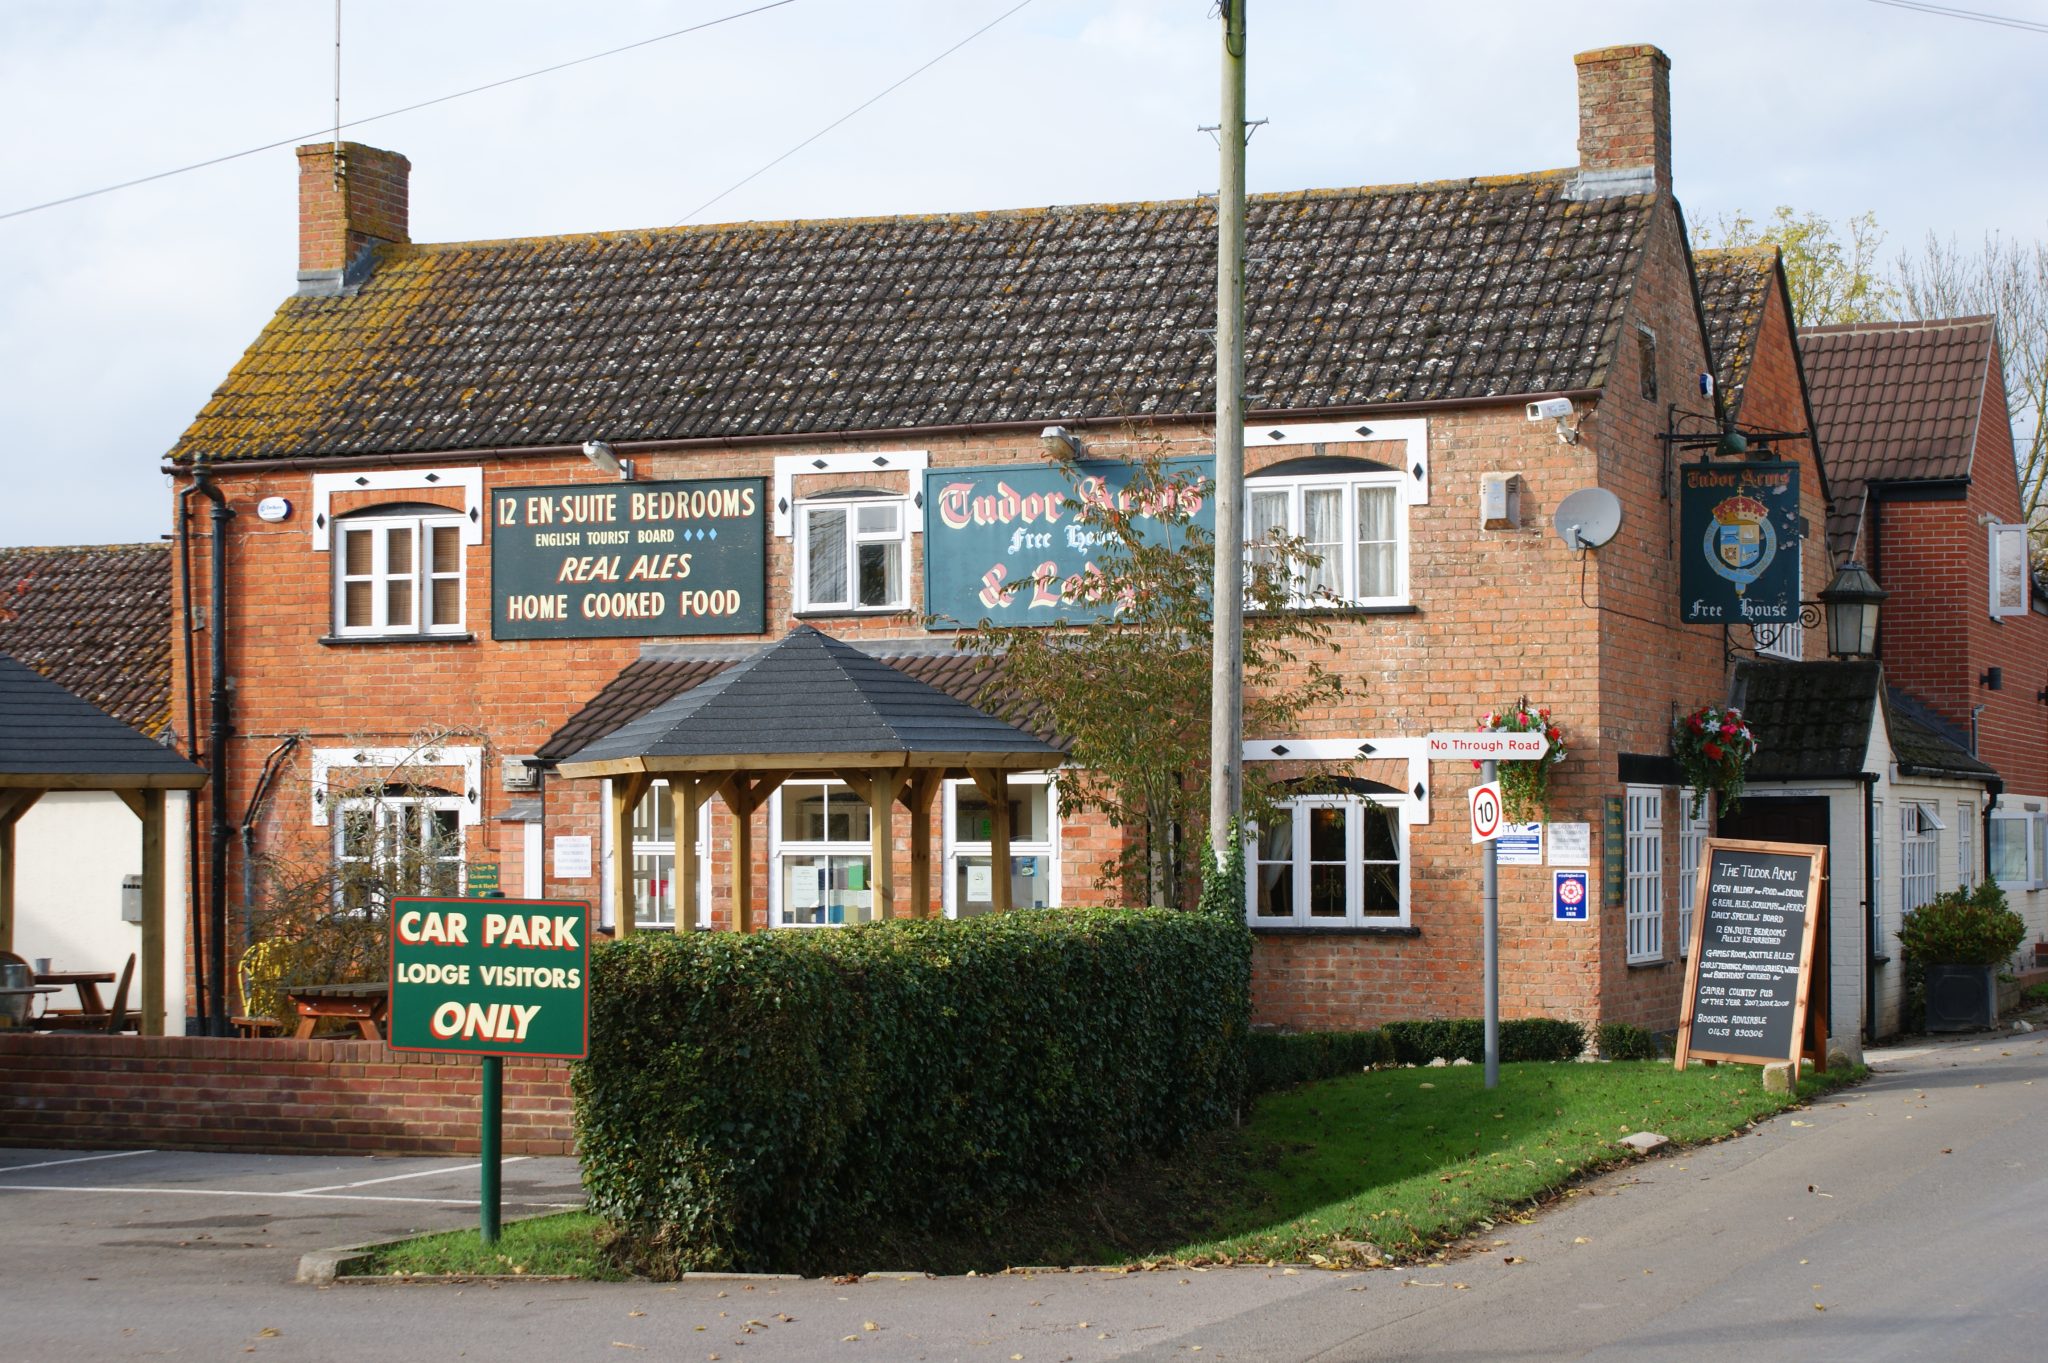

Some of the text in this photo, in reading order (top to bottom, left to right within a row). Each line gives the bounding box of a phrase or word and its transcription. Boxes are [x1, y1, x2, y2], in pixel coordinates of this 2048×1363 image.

[1688, 469, 1791, 488] Tudor Arms
[499, 497, 517, 525] 12
[630, 487, 756, 523] BEDROOMS
[938, 481, 1066, 529] Tudor
[535, 528, 675, 547] ENGLISH TOURIST BOARD
[1007, 527, 1052, 555] Free
[558, 553, 693, 583] REAL ALES
[1028, 560, 1158, 618] Lodg
[508, 589, 741, 620] HOME COOKED FOOD
[1689, 598, 1787, 621] Free House
[1430, 740, 1540, 752] No Through Road
[1477, 801, 1494, 824] 10
[1719, 863, 1797, 881] THE TUDOR ARMS
[1712, 884, 1731, 893] OPEN
[1761, 887, 1777, 895] FOOD
[1785, 889, 1804, 897] DRINK
[1712, 898, 1718, 907] 6
[1718, 899, 1734, 908] REAL
[1711, 911, 1784, 923] DAILY SPECIALS BOARD
[397, 911, 580, 950] CAR PARK
[1753, 927, 1787, 938] BEDROOMS
[397, 963, 581, 989] LODGE VISITORS
[1710, 998, 1724, 1006] THE
[1760, 989, 1773, 998] PUB
[430, 1001, 542, 1043] ONLY
[1697, 1013, 1729, 1024] BOOKING
